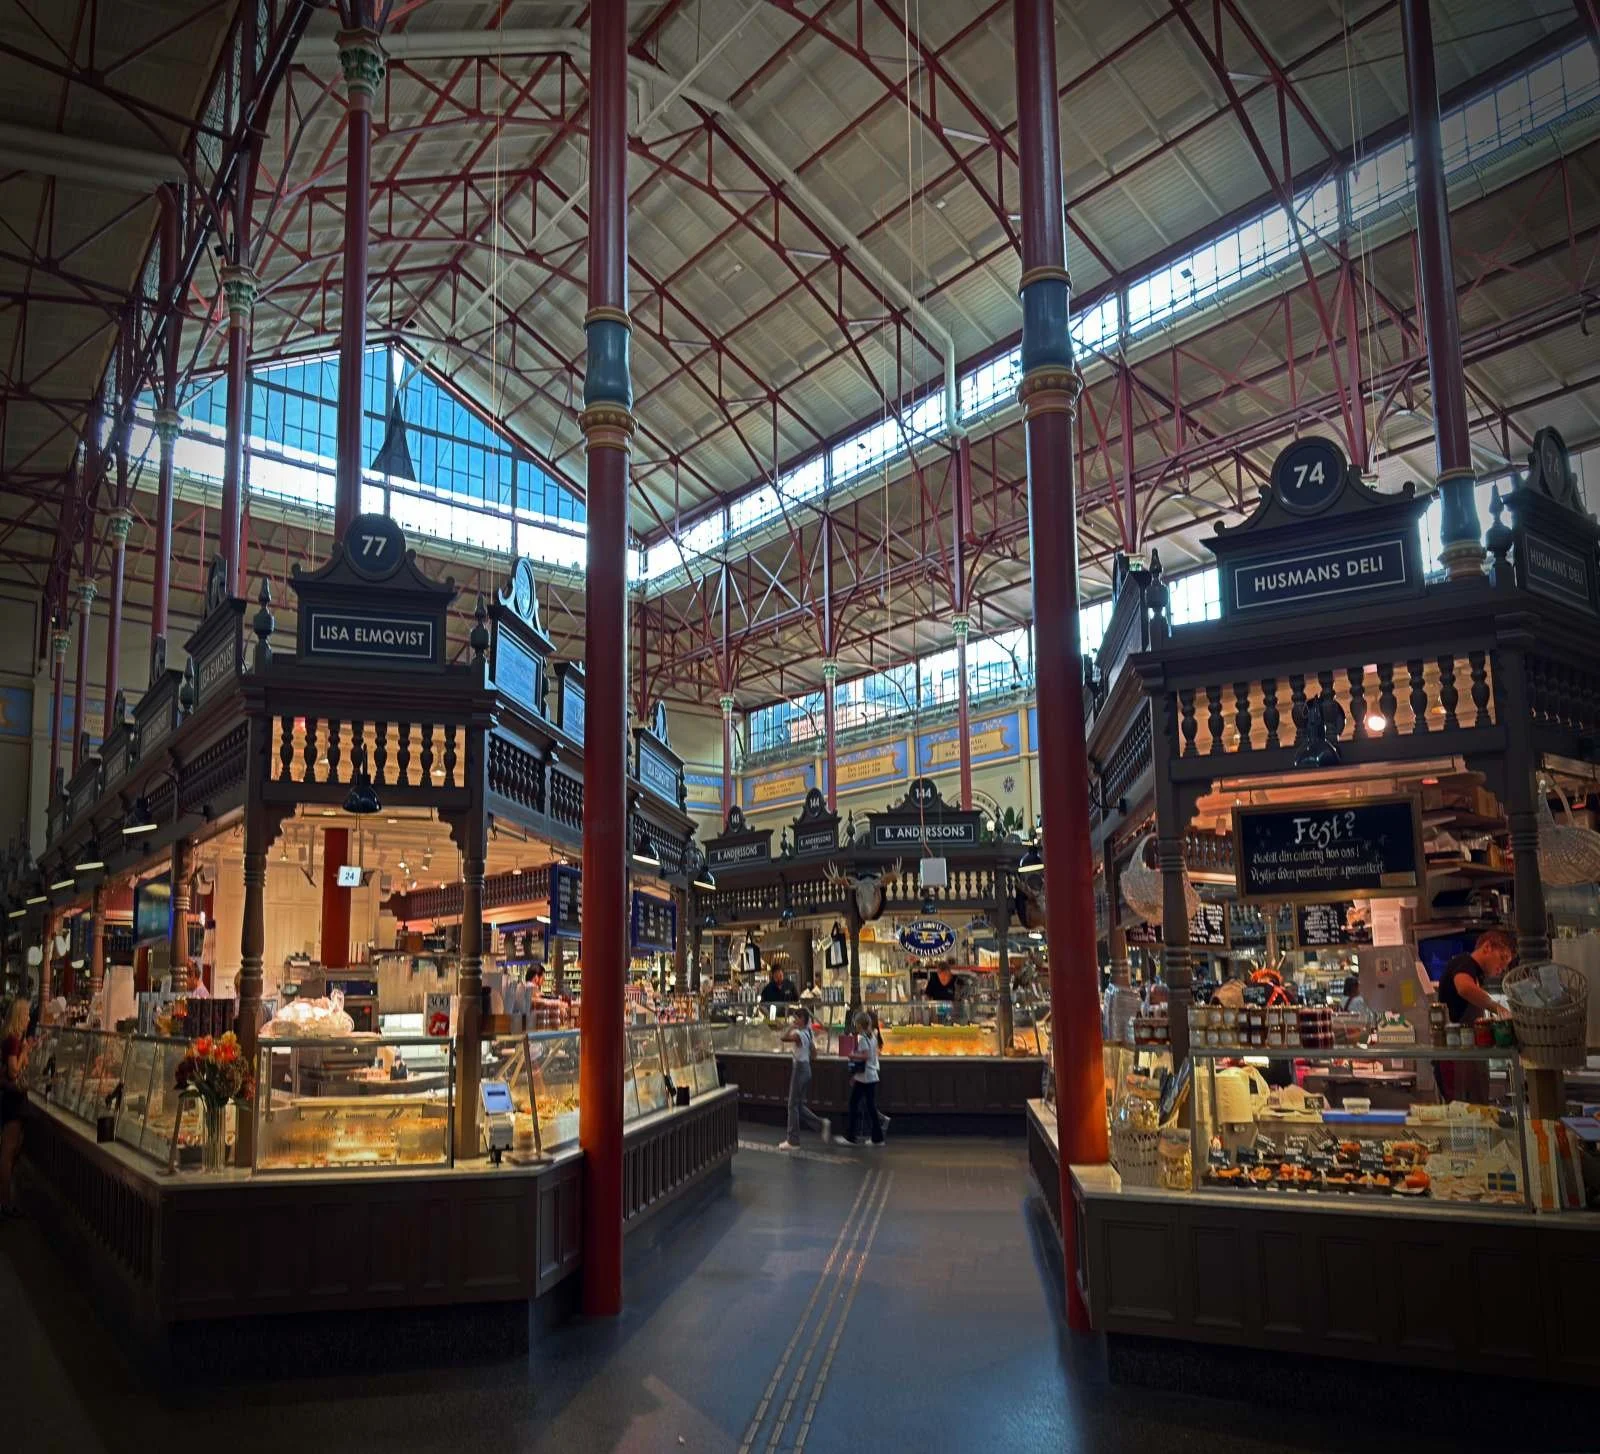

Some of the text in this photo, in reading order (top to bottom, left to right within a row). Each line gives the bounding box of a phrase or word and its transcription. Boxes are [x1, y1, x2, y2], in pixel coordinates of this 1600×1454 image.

[1293, 461, 1325, 489] 74
[361, 535, 387, 557] 77
[1254, 555, 1383, 592] HUSMANS DELI
[320, 625, 425, 646] LISA ELMQVIST
[885, 827, 894, 838] B.
